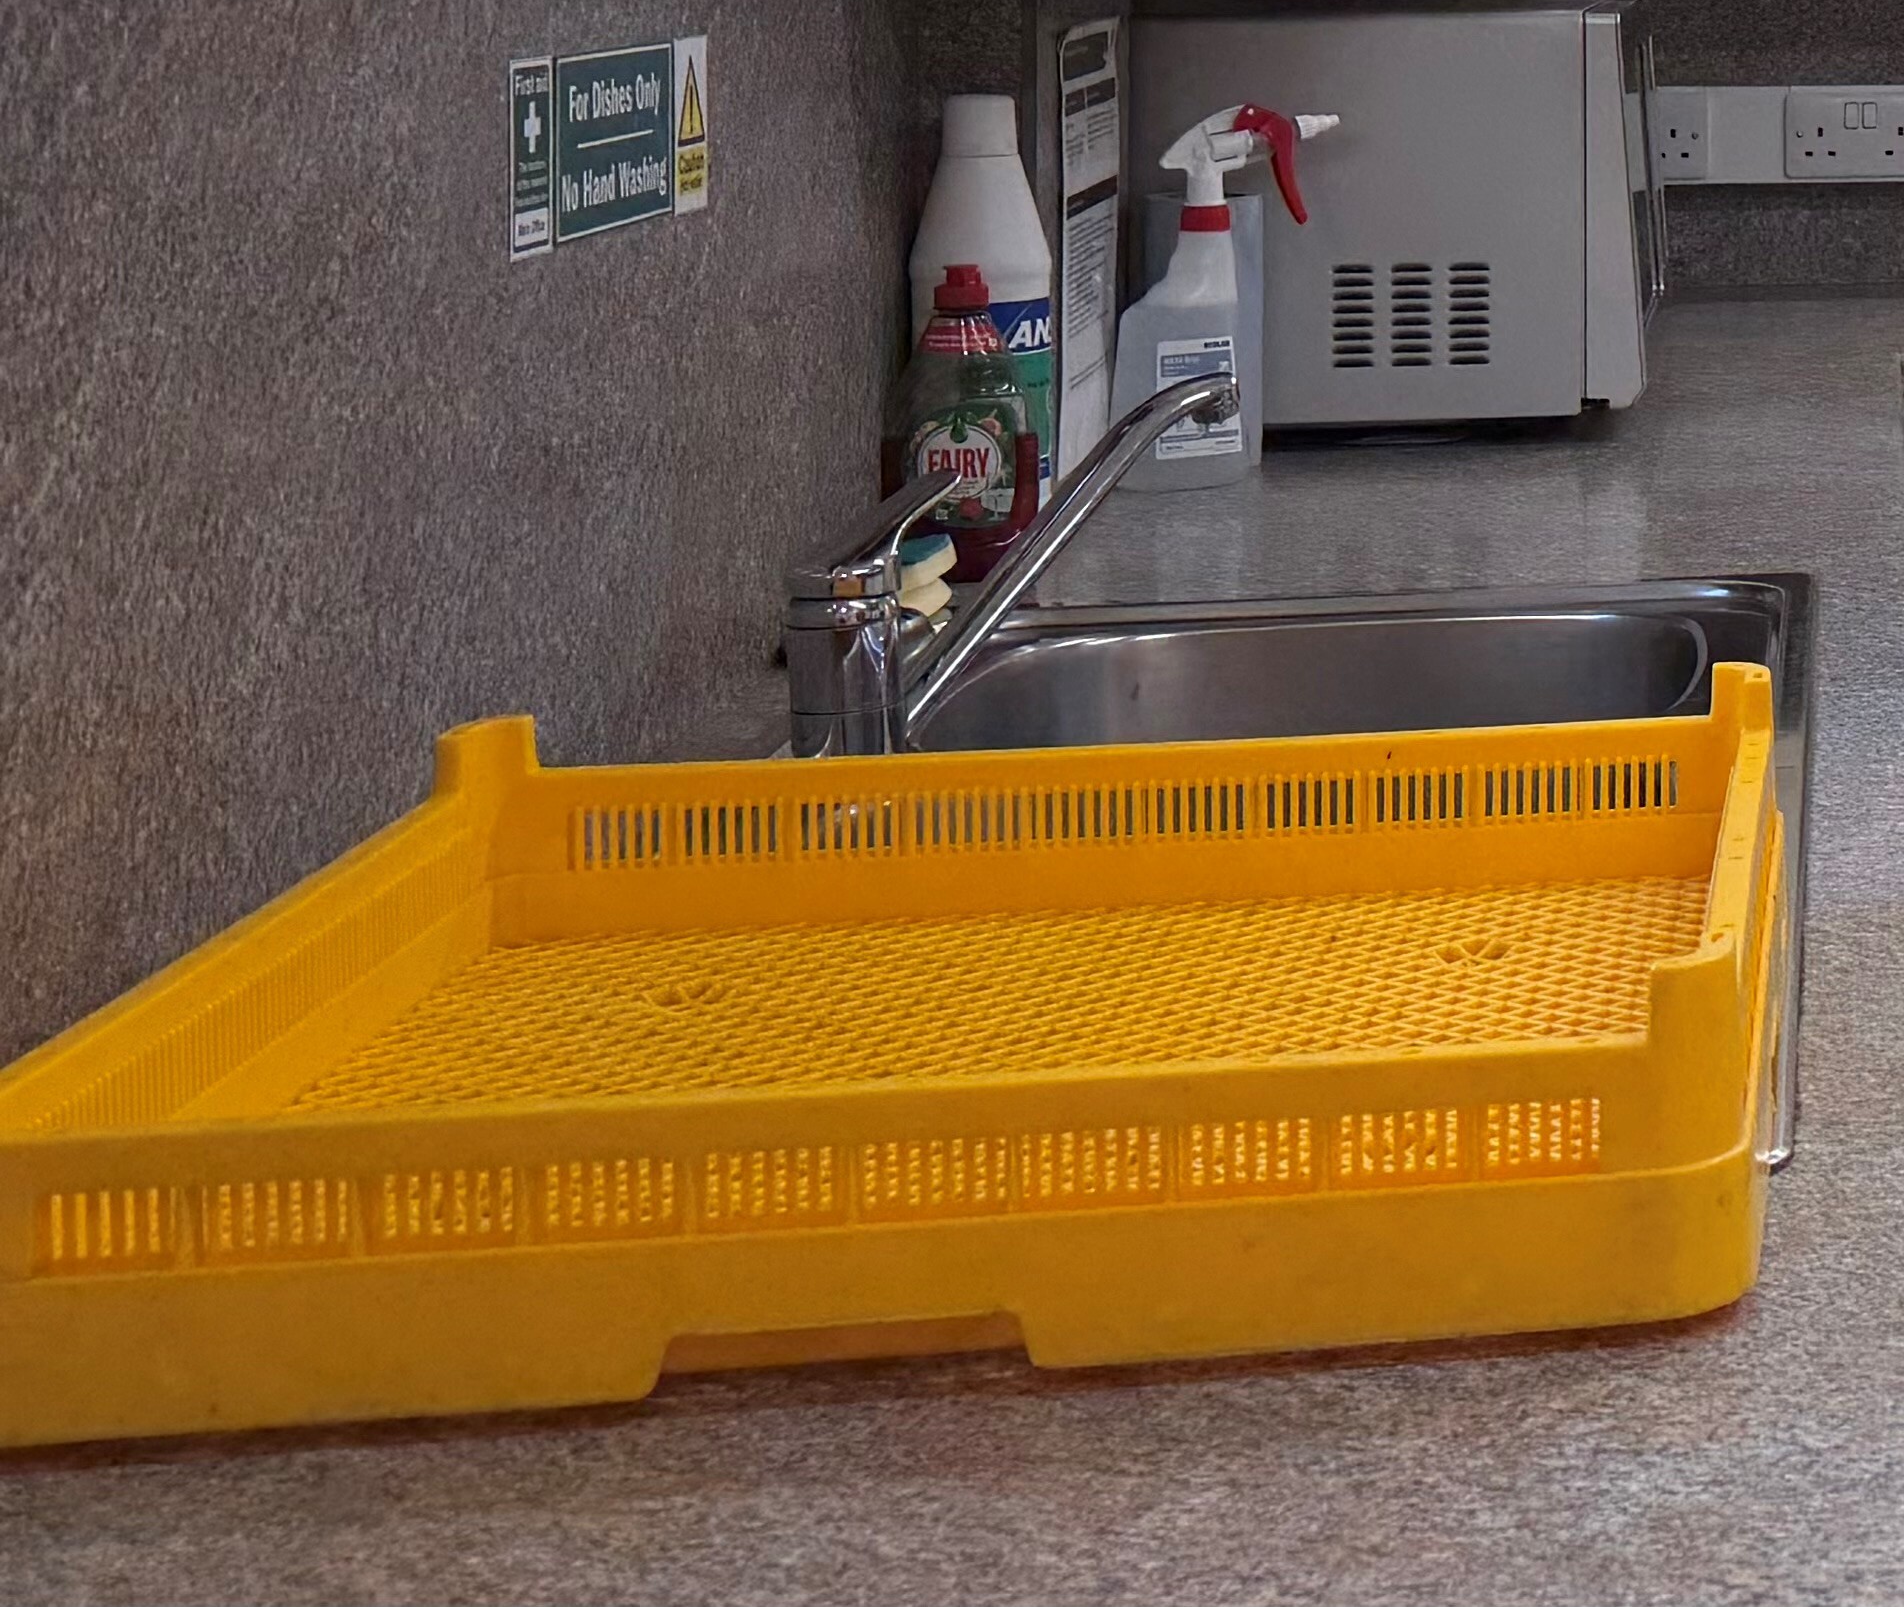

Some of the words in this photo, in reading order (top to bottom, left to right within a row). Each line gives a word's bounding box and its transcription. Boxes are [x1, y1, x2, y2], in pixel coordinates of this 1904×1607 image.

[568, 85, 589, 123] For
[592, 76, 633, 119] Dishes
[635, 72, 661, 116] Only
[561, 174, 579, 213] No
[582, 164, 616, 206] Hand
[618, 157, 667, 199] Washing
[928, 447, 989, 479] FAIRY
